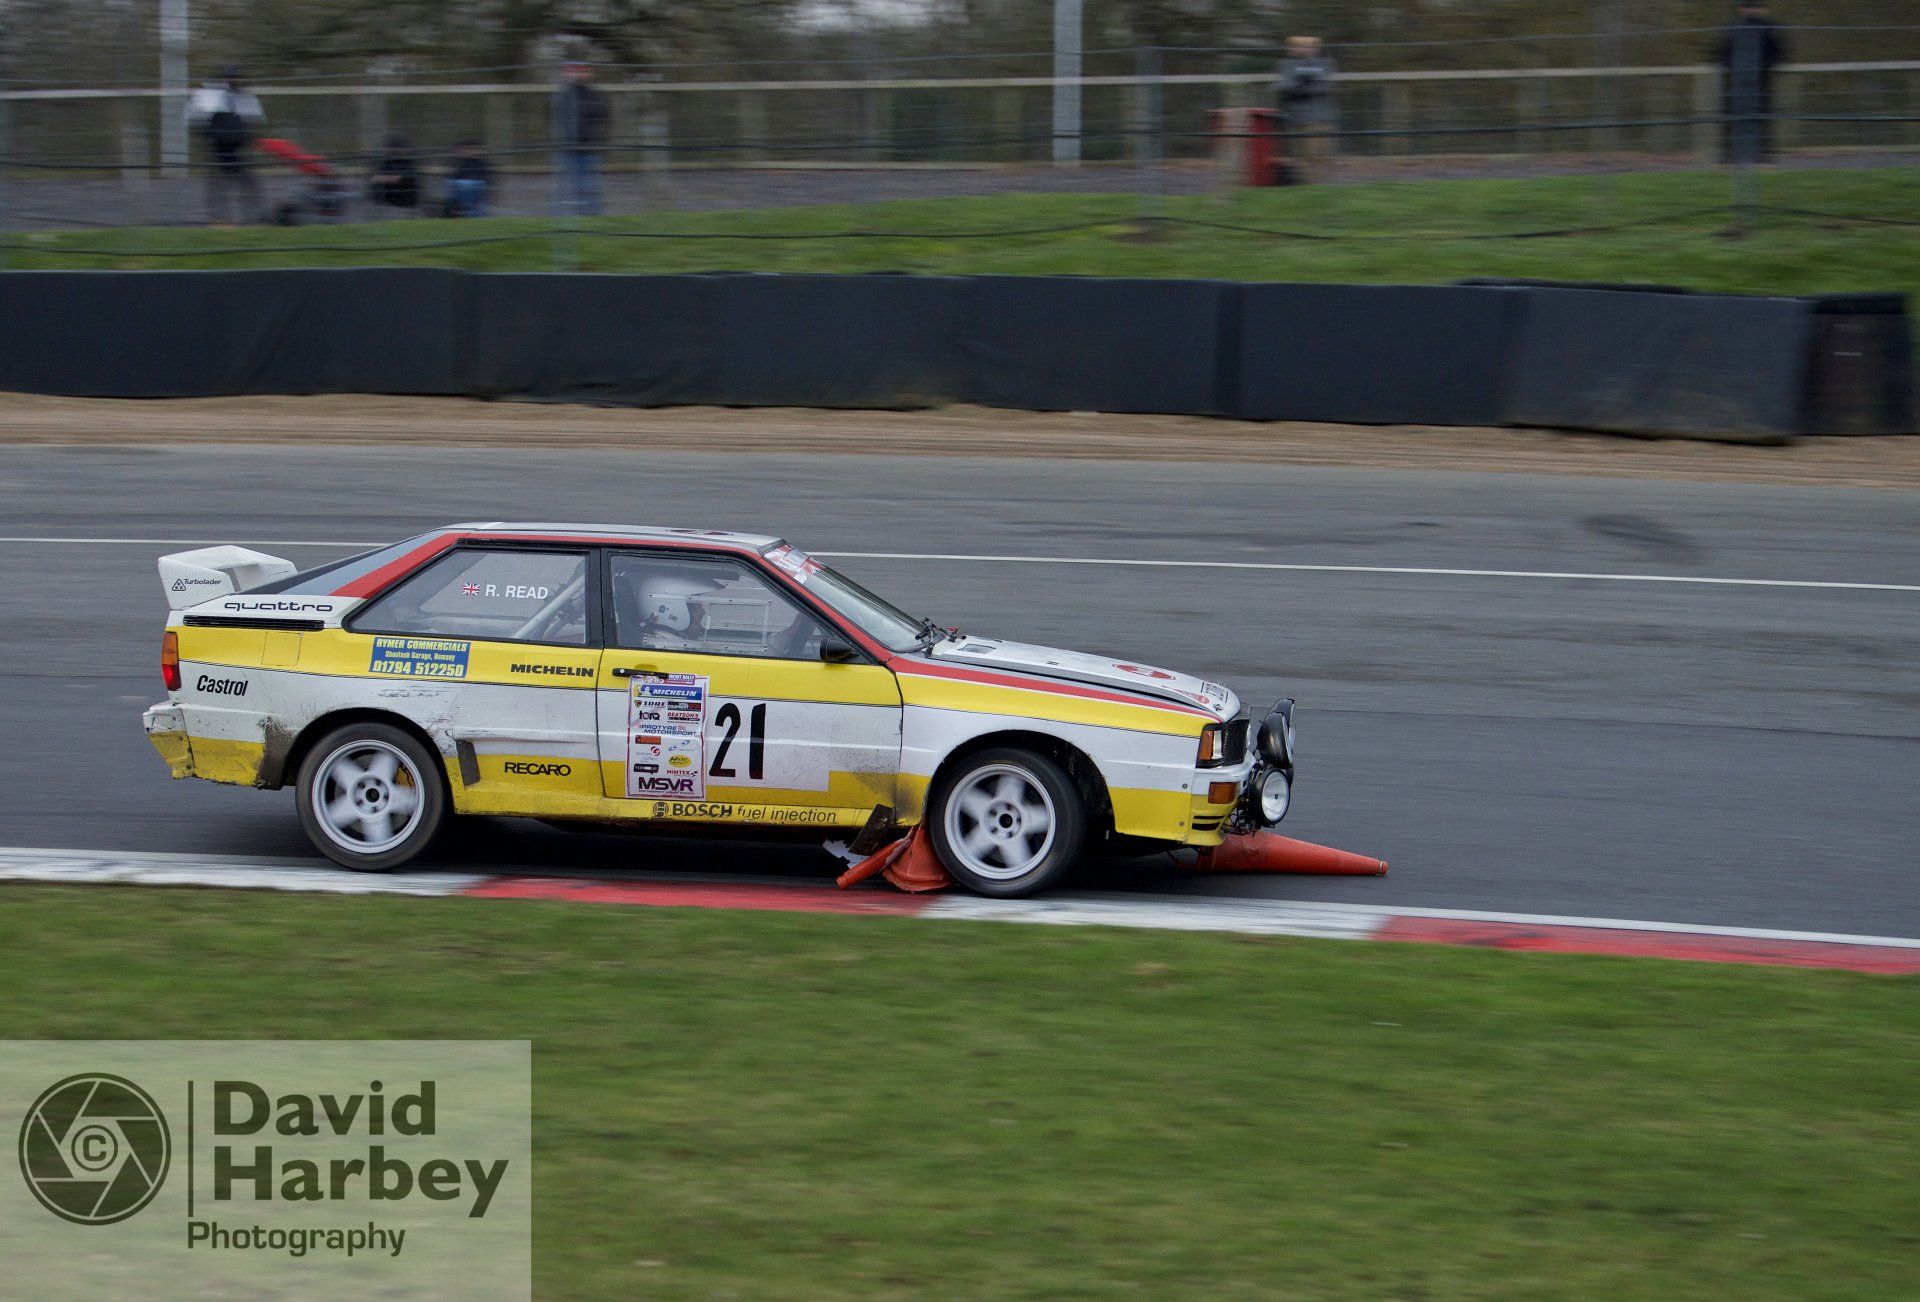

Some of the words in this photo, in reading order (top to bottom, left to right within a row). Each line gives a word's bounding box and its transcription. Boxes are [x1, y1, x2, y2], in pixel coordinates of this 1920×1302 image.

[485, 584, 500, 597] R.
[505, 585, 549, 599] READ
[224, 601, 333, 612] quattro
[406, 640, 468, 652] COMMERCIALS
[372, 660, 412, 674] 01794
[415, 661, 465, 677] 512250
[510, 663, 594, 678] MICHELIN
[196, 674, 249, 696] Castrol
[652, 688, 697, 697] MICHELIN
[643, 728, 697, 736] MOTORSPORT
[709, 703, 767, 780] 21
[504, 761, 572, 777] RECARO
[638, 776, 694, 792] MSVR
[672, 803, 733, 818] BOSCH
[737, 805, 767, 819] fuel
[770, 807, 837, 823] injection
